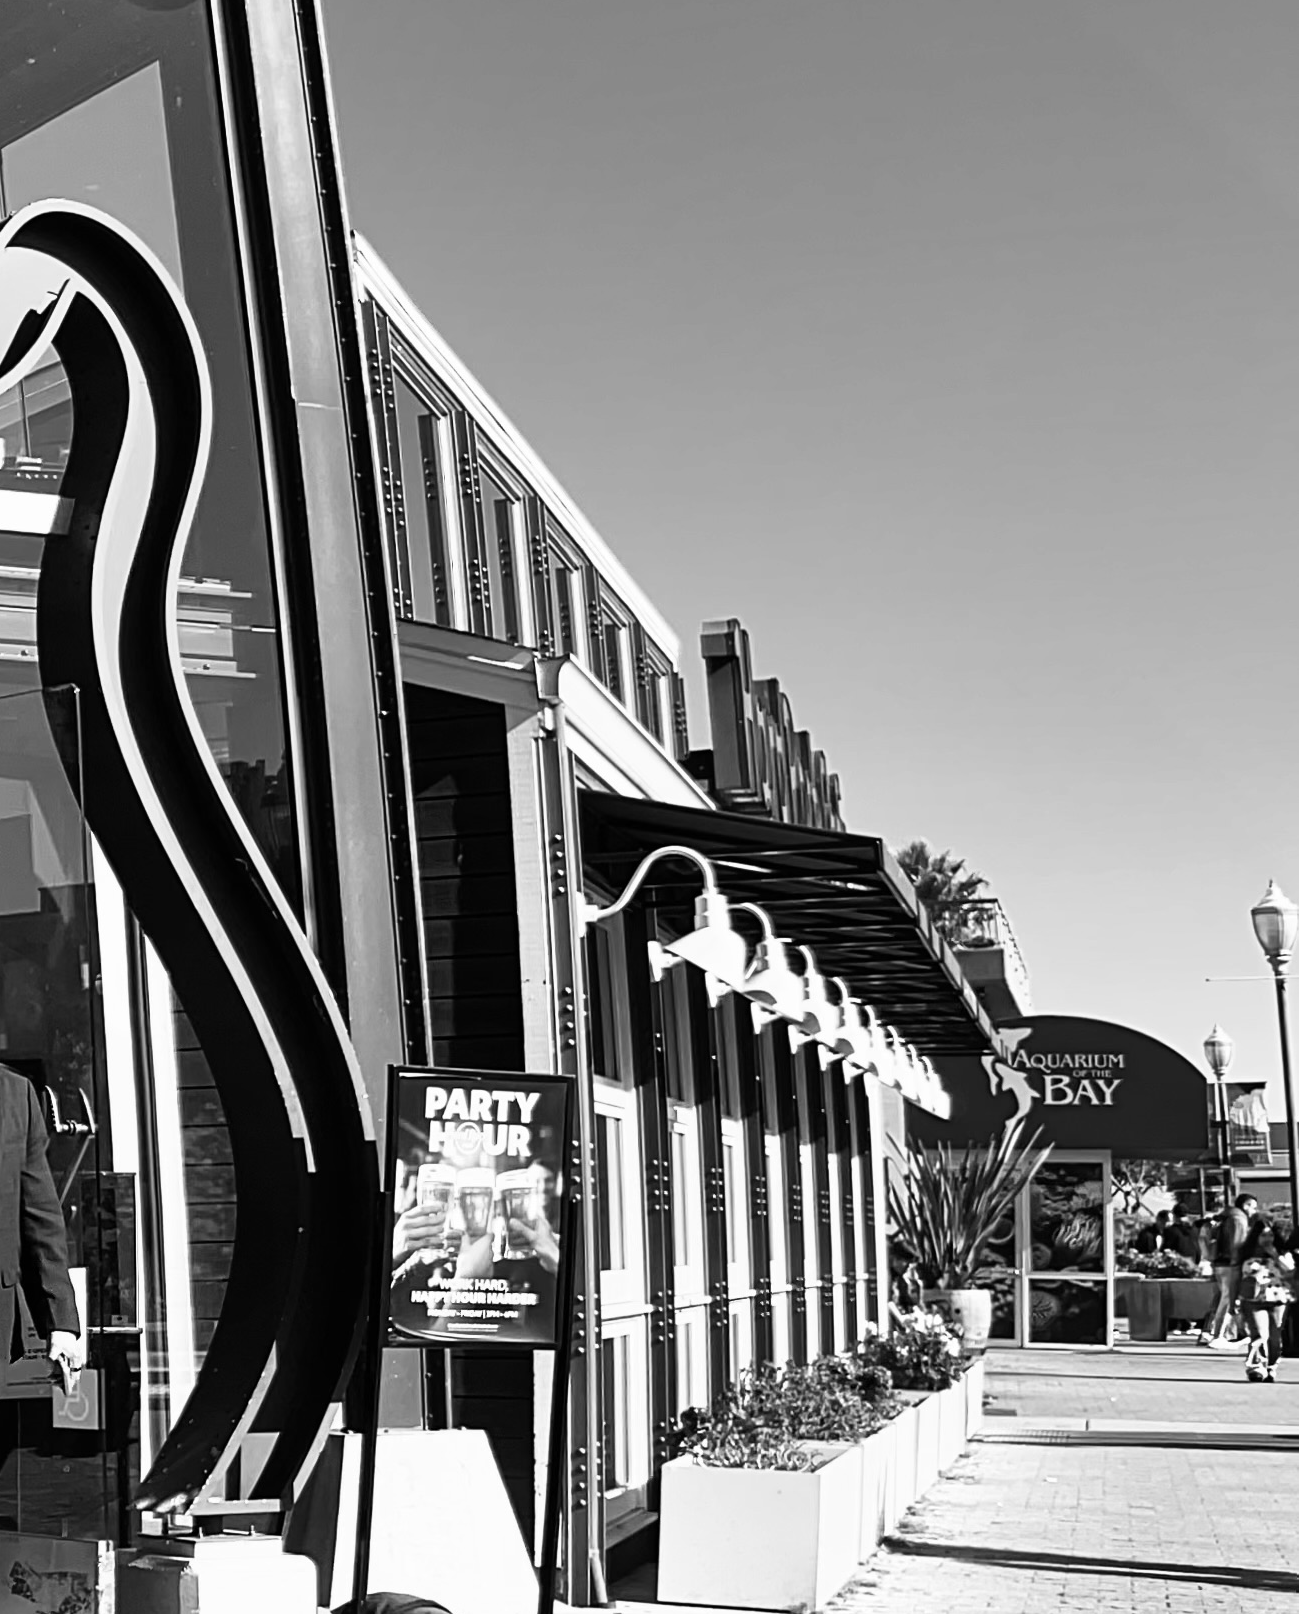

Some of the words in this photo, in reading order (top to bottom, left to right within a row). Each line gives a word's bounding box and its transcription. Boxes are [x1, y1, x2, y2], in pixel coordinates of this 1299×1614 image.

[1043, 1074, 1123, 1105] BAY
[1072, 1069, 1086, 1078] OF
[1091, 1069, 1112, 1078] THE
[425, 1086, 541, 1124] PARTY
[429, 1120, 532, 1157] HOUR
